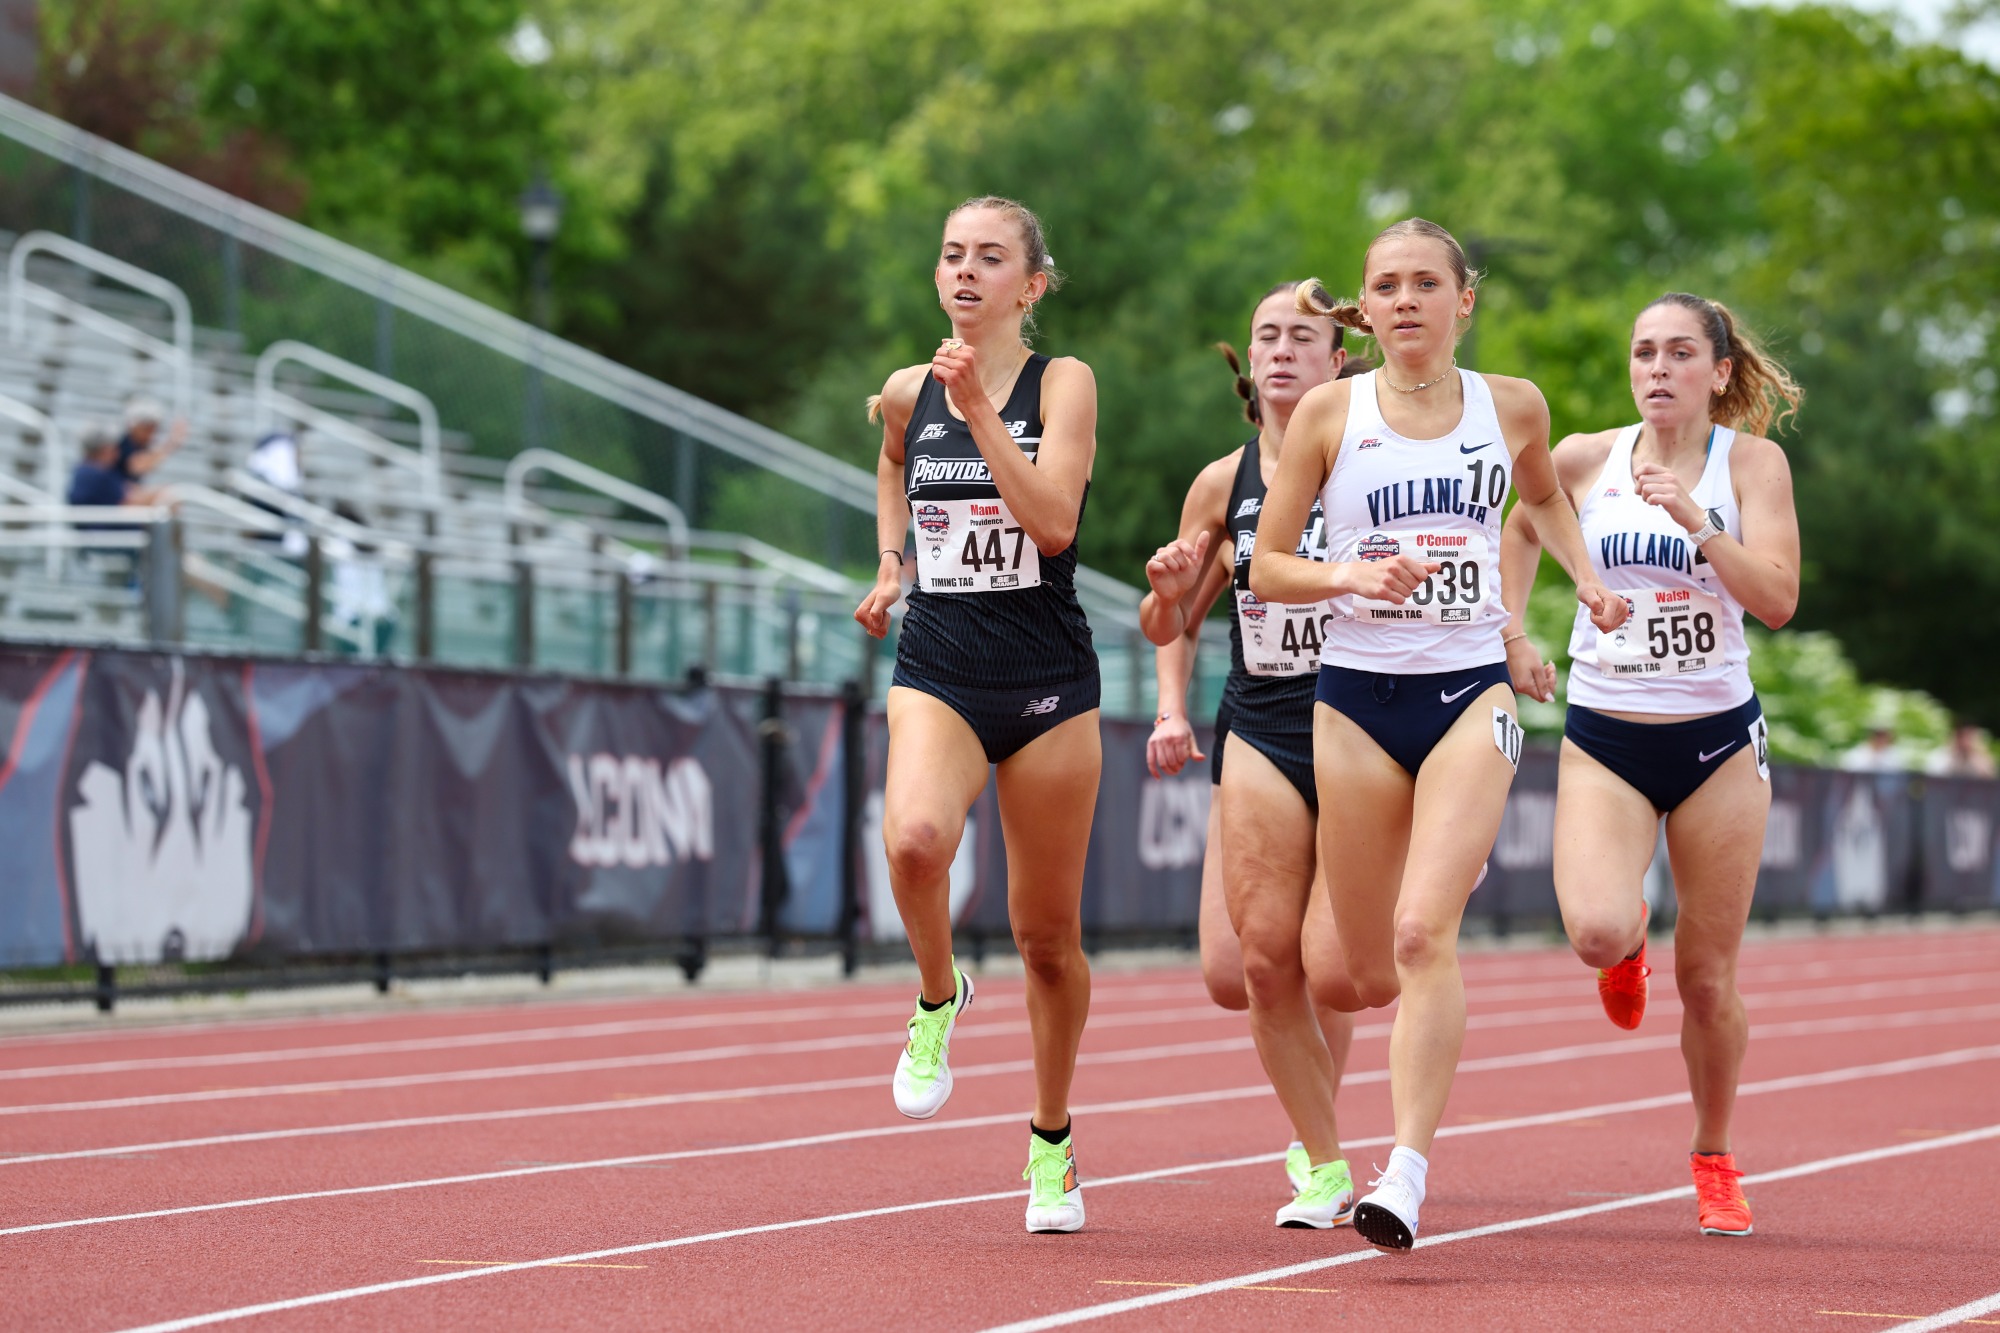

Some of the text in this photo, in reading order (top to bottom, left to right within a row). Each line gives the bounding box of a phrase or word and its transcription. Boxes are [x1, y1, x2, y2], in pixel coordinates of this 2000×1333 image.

[925, 423, 945, 432] BIG
[919, 430, 949, 439] EAST
[910, 456, 991, 489] PROVIDE
[1467, 459, 1506, 509] 10
[970, 504, 999, 516] Mann
[1237, 505, 1262, 514] EAST
[970, 518, 1003, 526] Providence
[1416, 534, 1468, 547] O'Connor
[961, 527, 1025, 573] 447
[1358, 544, 1399, 553] CHAMPIONSHIPS
[930, 577, 974, 587] TIMING TAG
[1655, 590, 1690, 604] Walsh
[1370, 609, 1423, 619] TIMING TAG
[1659, 605, 1690, 613] Villanova
[1648, 612, 1715, 659] 558
[1256, 662, 1294, 671] TIMING TAG
[1613, 663, 1661, 674] TIMING TAG
[1496, 713, 1520, 766] 10
